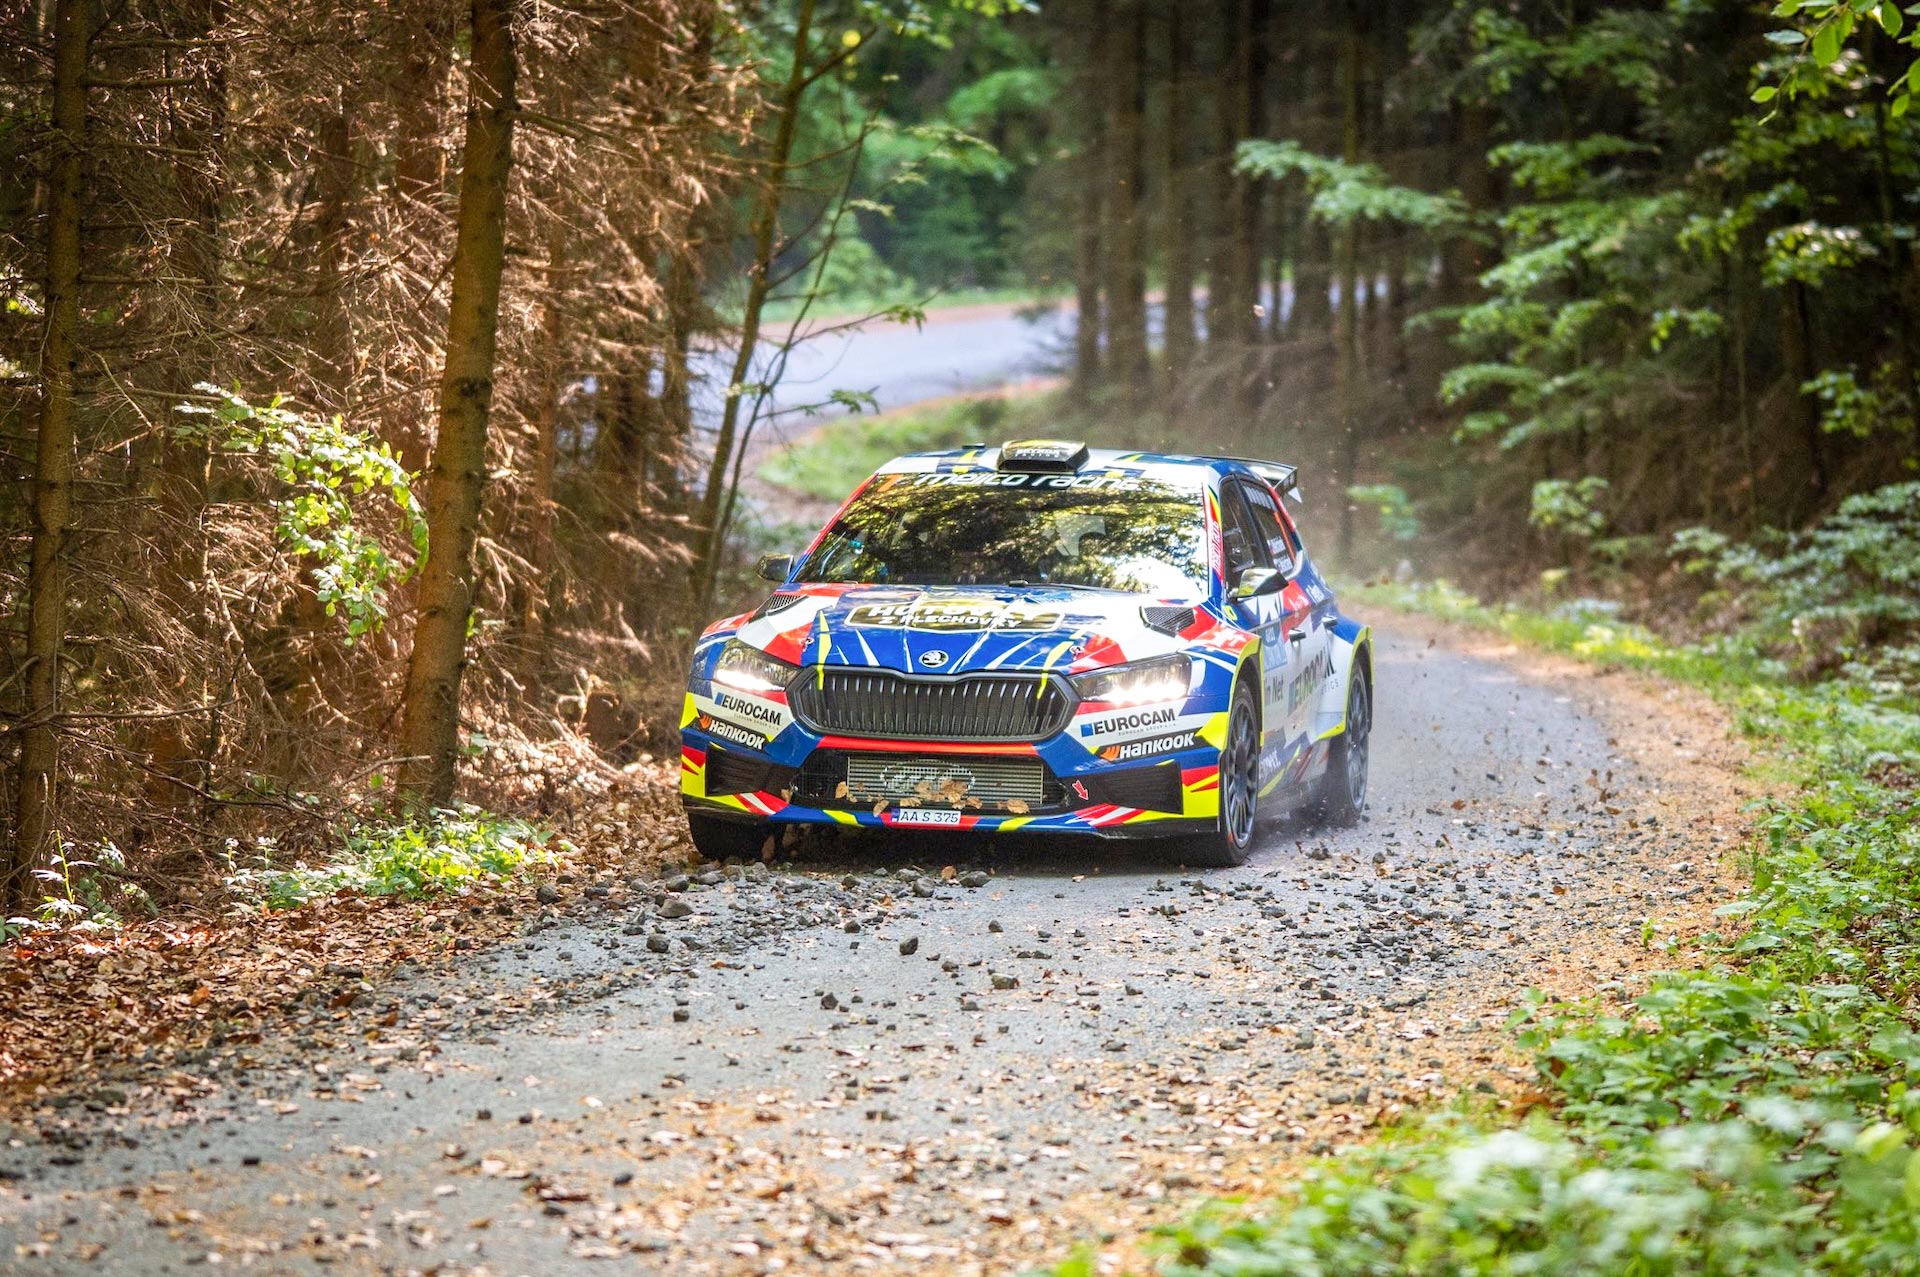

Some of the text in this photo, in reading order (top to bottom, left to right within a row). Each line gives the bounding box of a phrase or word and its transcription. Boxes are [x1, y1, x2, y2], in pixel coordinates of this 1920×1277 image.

[721, 694, 782, 726] EUROCAM
[1093, 708, 1176, 735] EUROCAM
[900, 811, 960, 823] AA S 375
